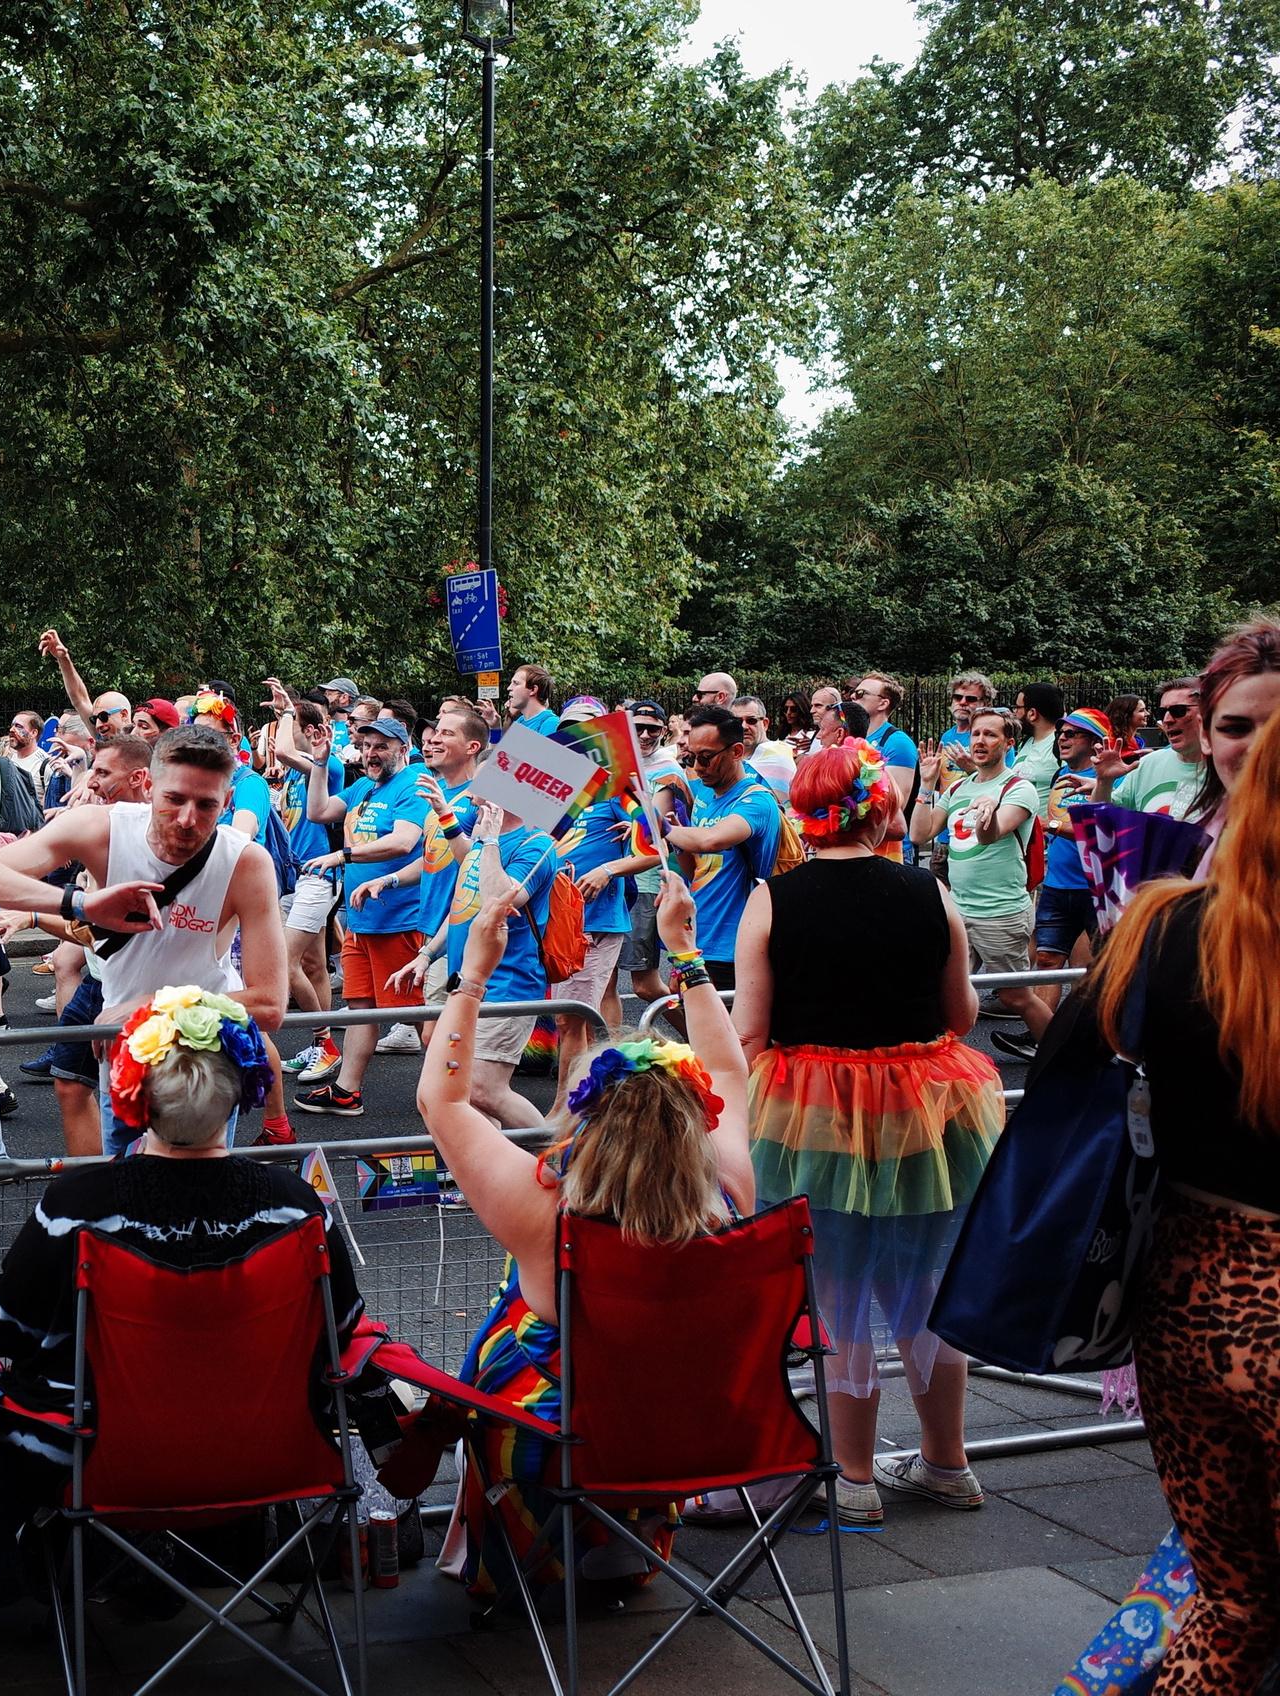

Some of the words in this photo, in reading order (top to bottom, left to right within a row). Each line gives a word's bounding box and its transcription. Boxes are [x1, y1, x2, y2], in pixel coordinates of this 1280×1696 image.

[477, 652, 488, 660] Sat
[514, 762, 574, 803] QUEER
[169, 902, 197, 919] LDN
[168, 914, 215, 934] RIDERS
